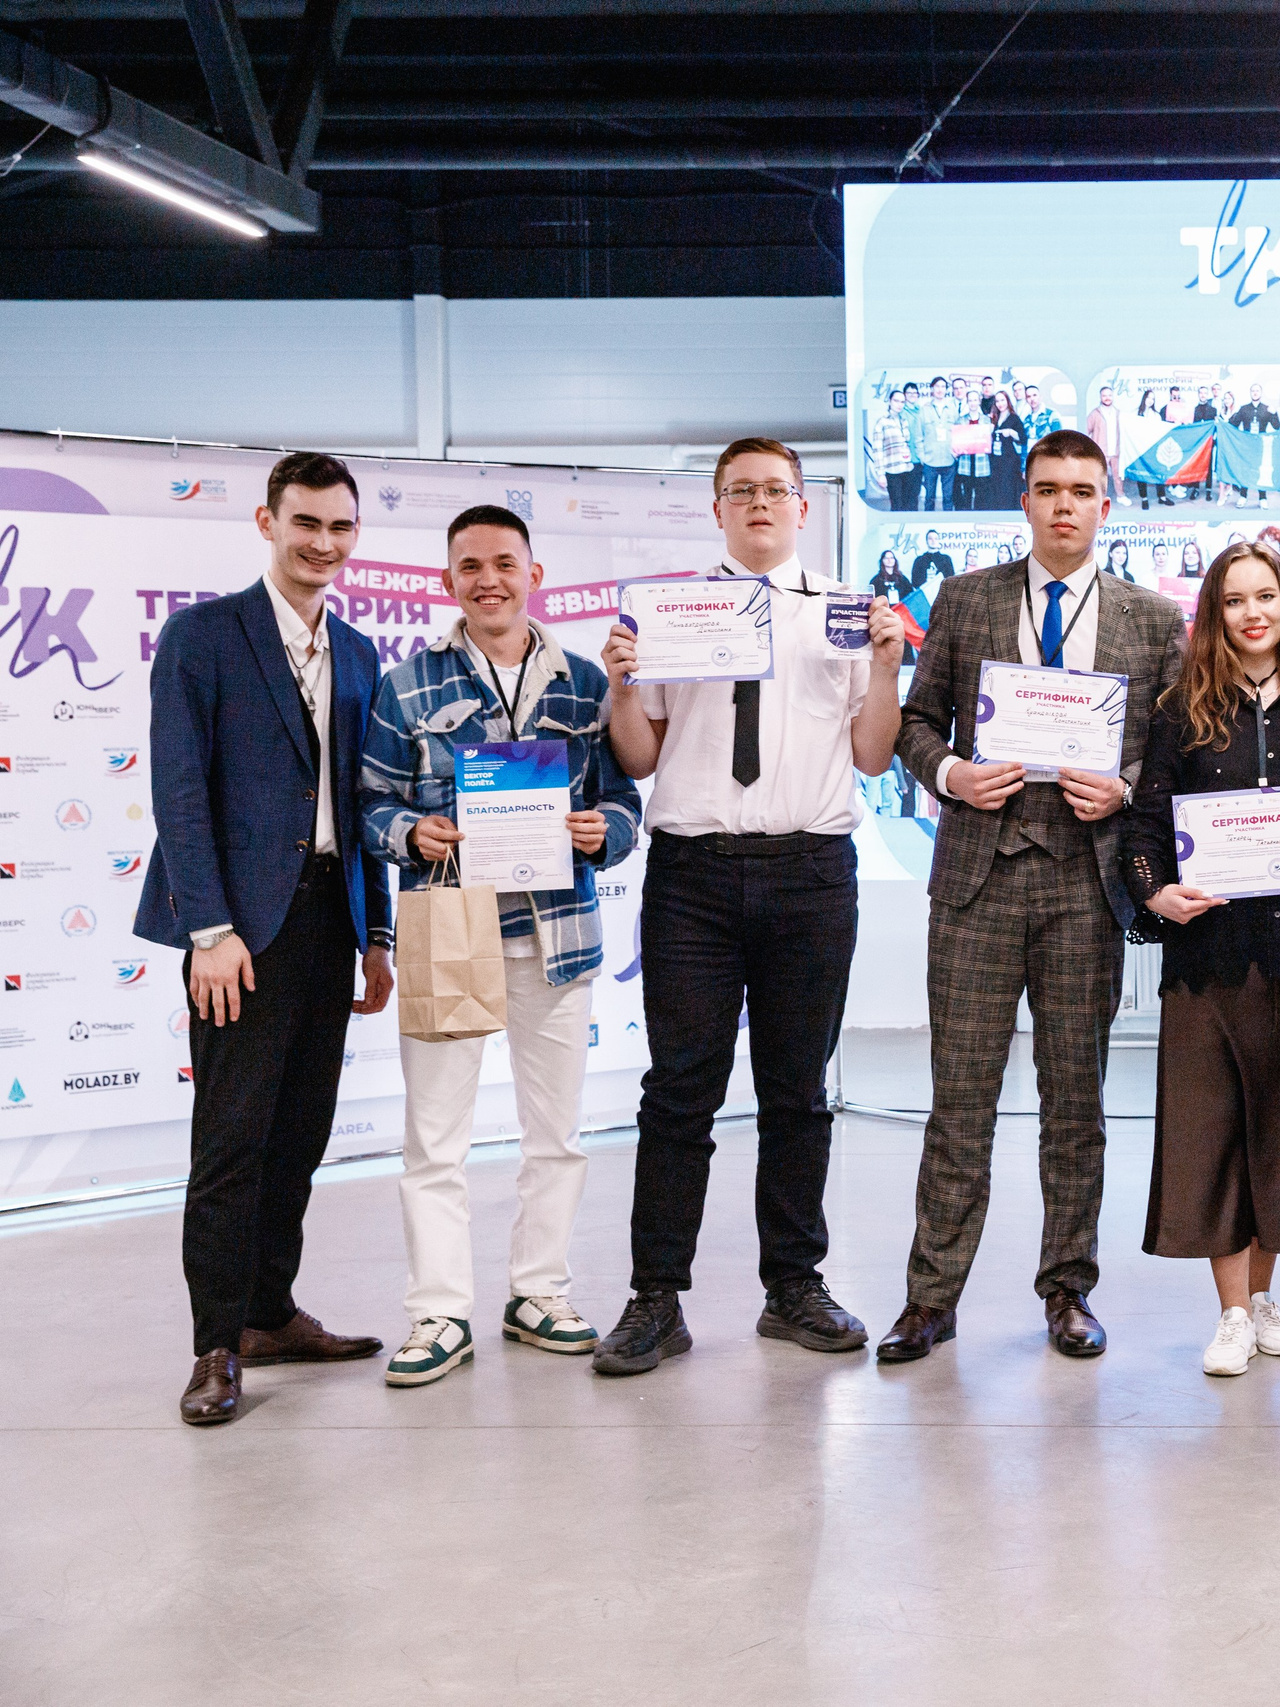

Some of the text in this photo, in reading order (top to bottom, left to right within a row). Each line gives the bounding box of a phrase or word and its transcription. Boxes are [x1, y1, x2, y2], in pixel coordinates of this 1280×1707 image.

[344, 566, 452, 597] МЕЖРЕ
[656, 602, 736, 613] СЕРТИФИКАТ
[1016, 689, 1092, 705] СЕРТИФИКАТ
[467, 803, 555, 815] БЛАГОДАРНОСТЬ
[598, 884, 627, 897] DZ.BY
[63, 1071, 140, 1091] MOLADZ.BY
